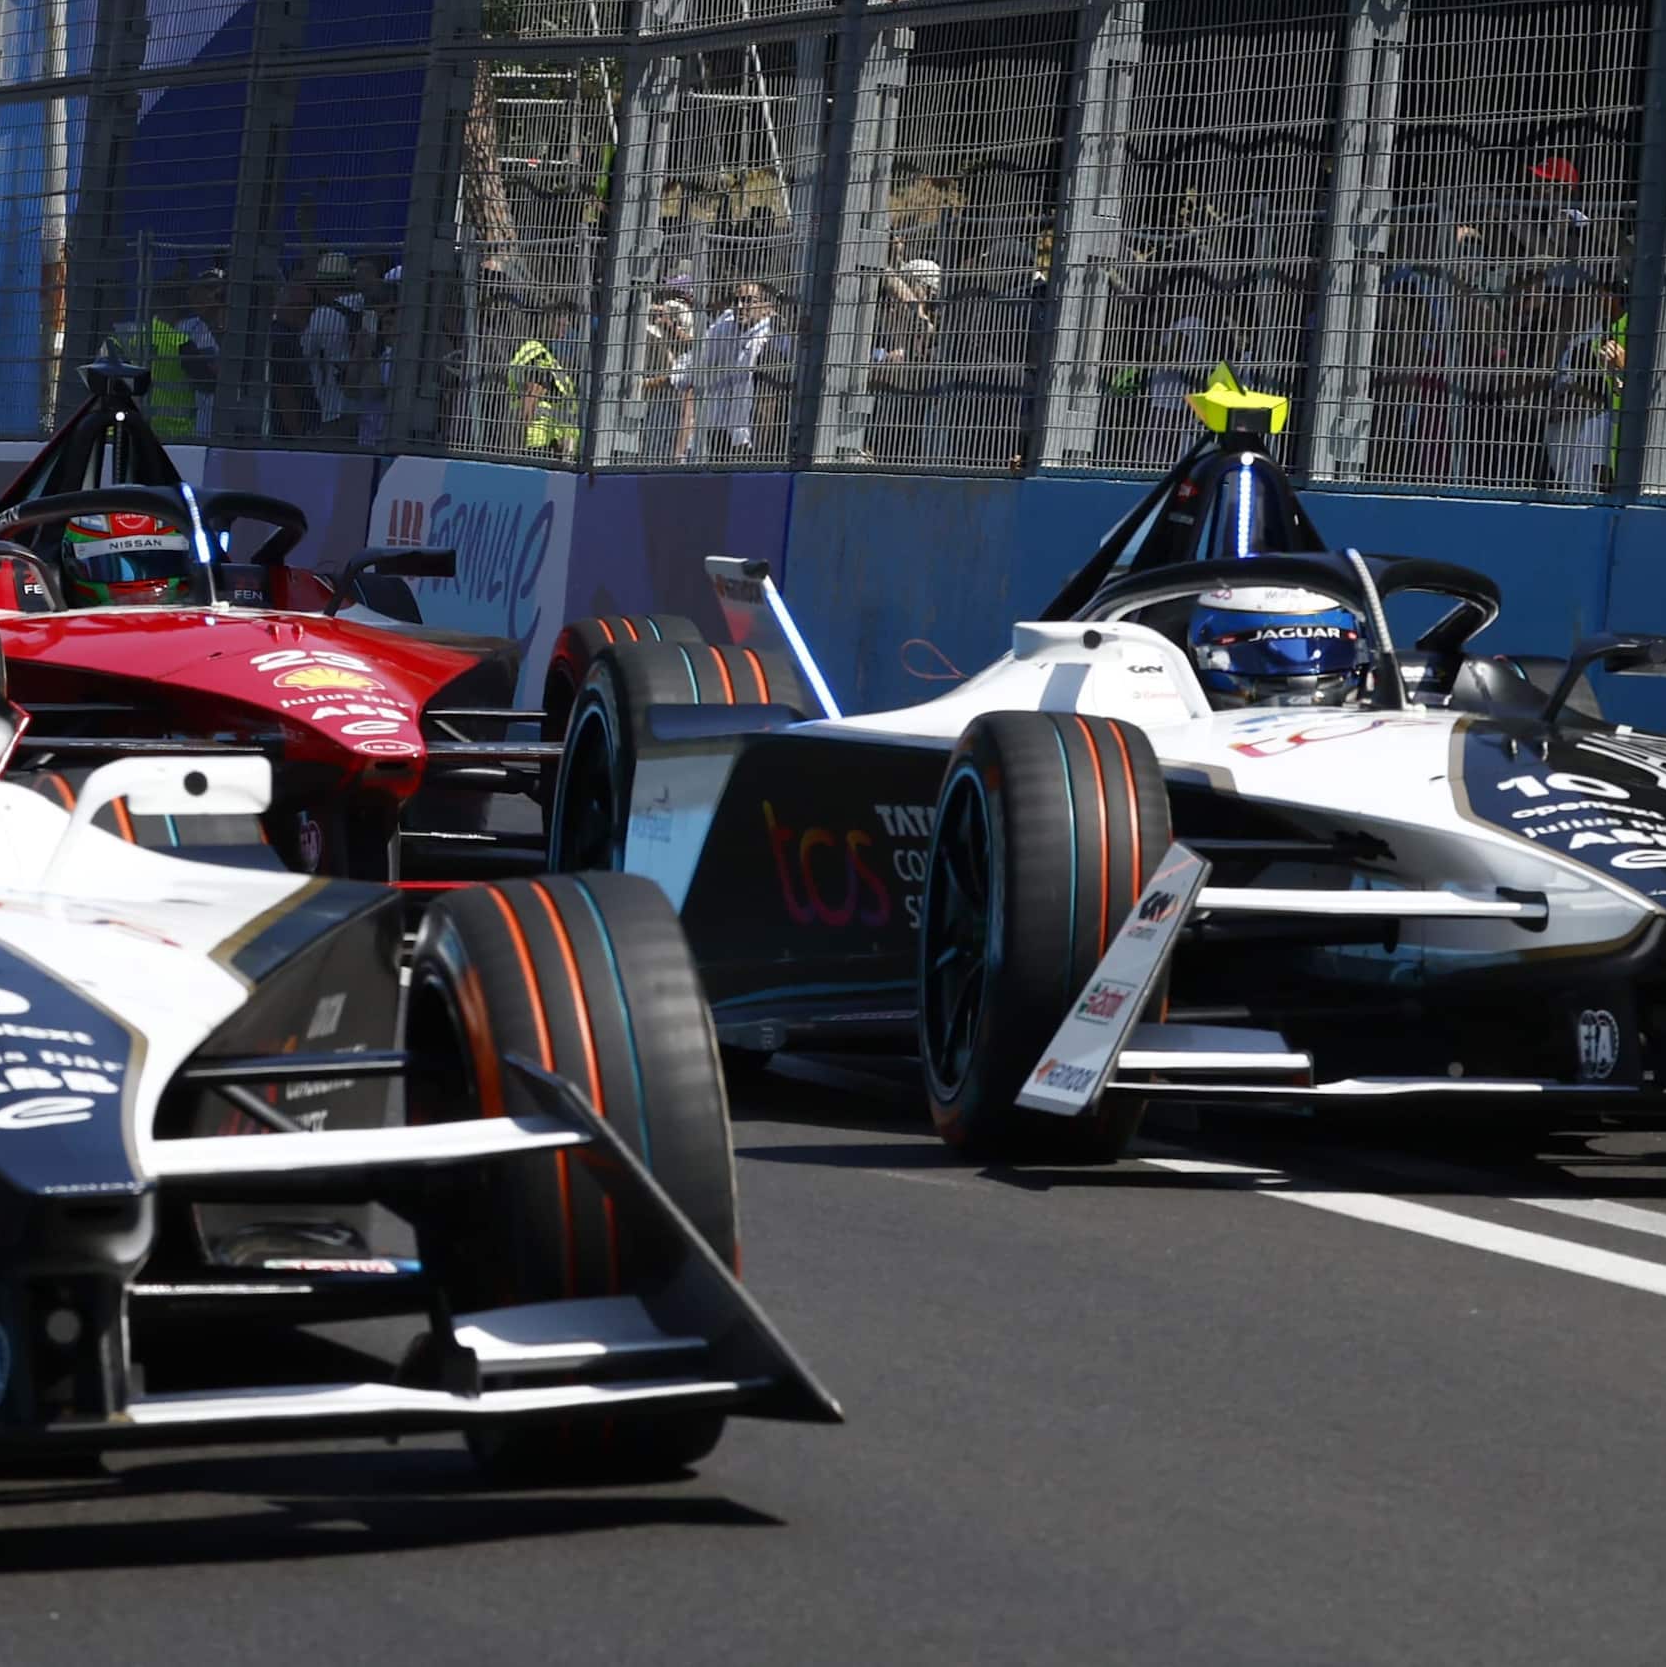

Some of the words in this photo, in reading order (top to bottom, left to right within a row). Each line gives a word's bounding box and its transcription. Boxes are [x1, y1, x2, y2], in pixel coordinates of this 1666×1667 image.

[108, 538, 164, 551] NISSAN
[1248, 626, 1342, 643] JAGUAR
[250, 649, 373, 672] 23
[1496, 771, 1632, 799] 10
